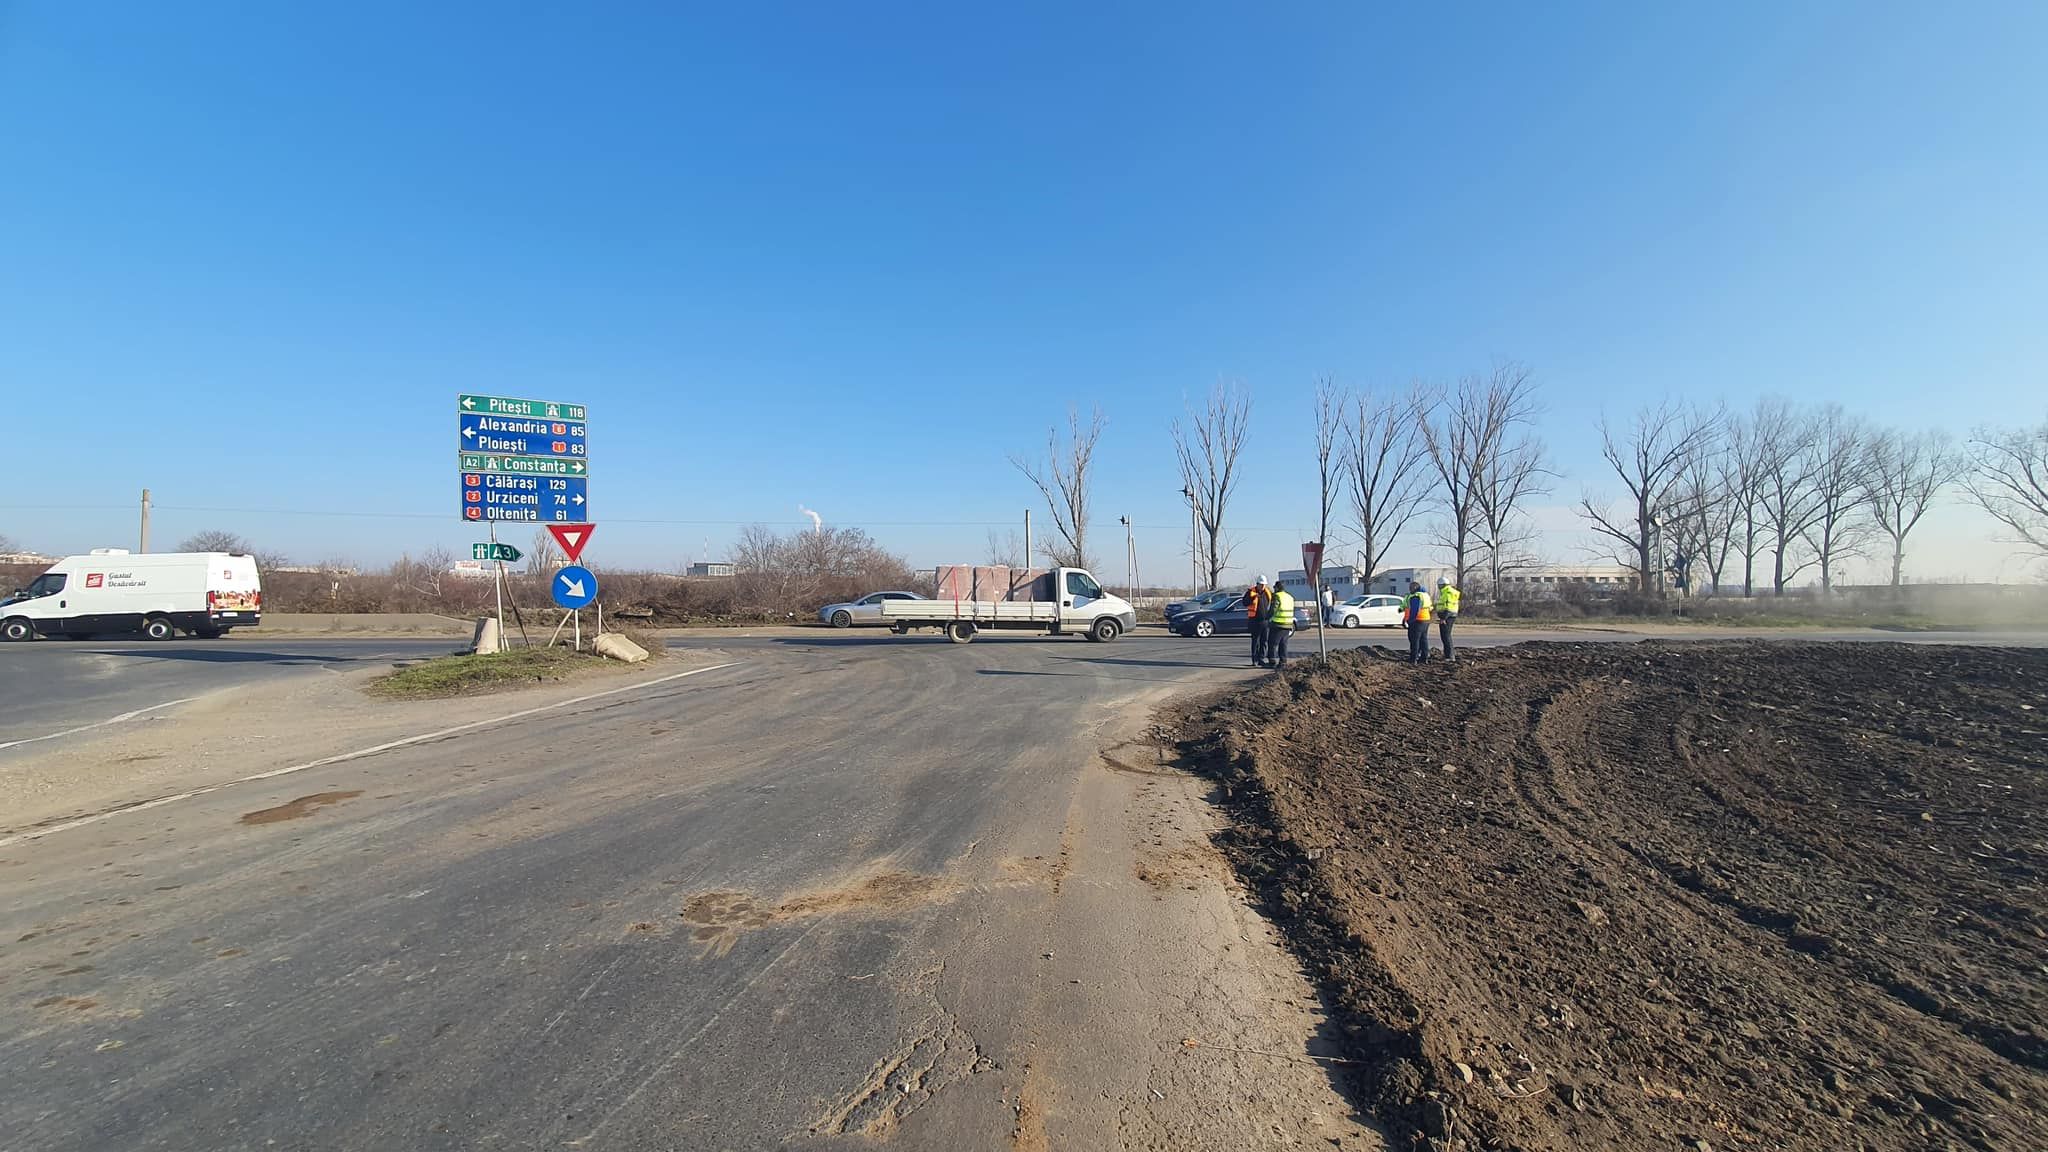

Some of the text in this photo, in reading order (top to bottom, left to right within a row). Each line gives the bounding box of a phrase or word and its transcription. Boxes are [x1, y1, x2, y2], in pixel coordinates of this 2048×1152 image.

[568, 407, 583, 418] 118
[479, 417, 547, 434] Alexandria
[571, 426, 584, 436] 85
[571, 444, 584, 454] 83
[465, 458, 477, 467] A2
[549, 479, 566, 490] 129
[486, 490, 538, 505] Urziceni
[554, 495, 566, 505] 74
[556, 510, 567, 520] 61
[492, 546, 512, 559] A3
